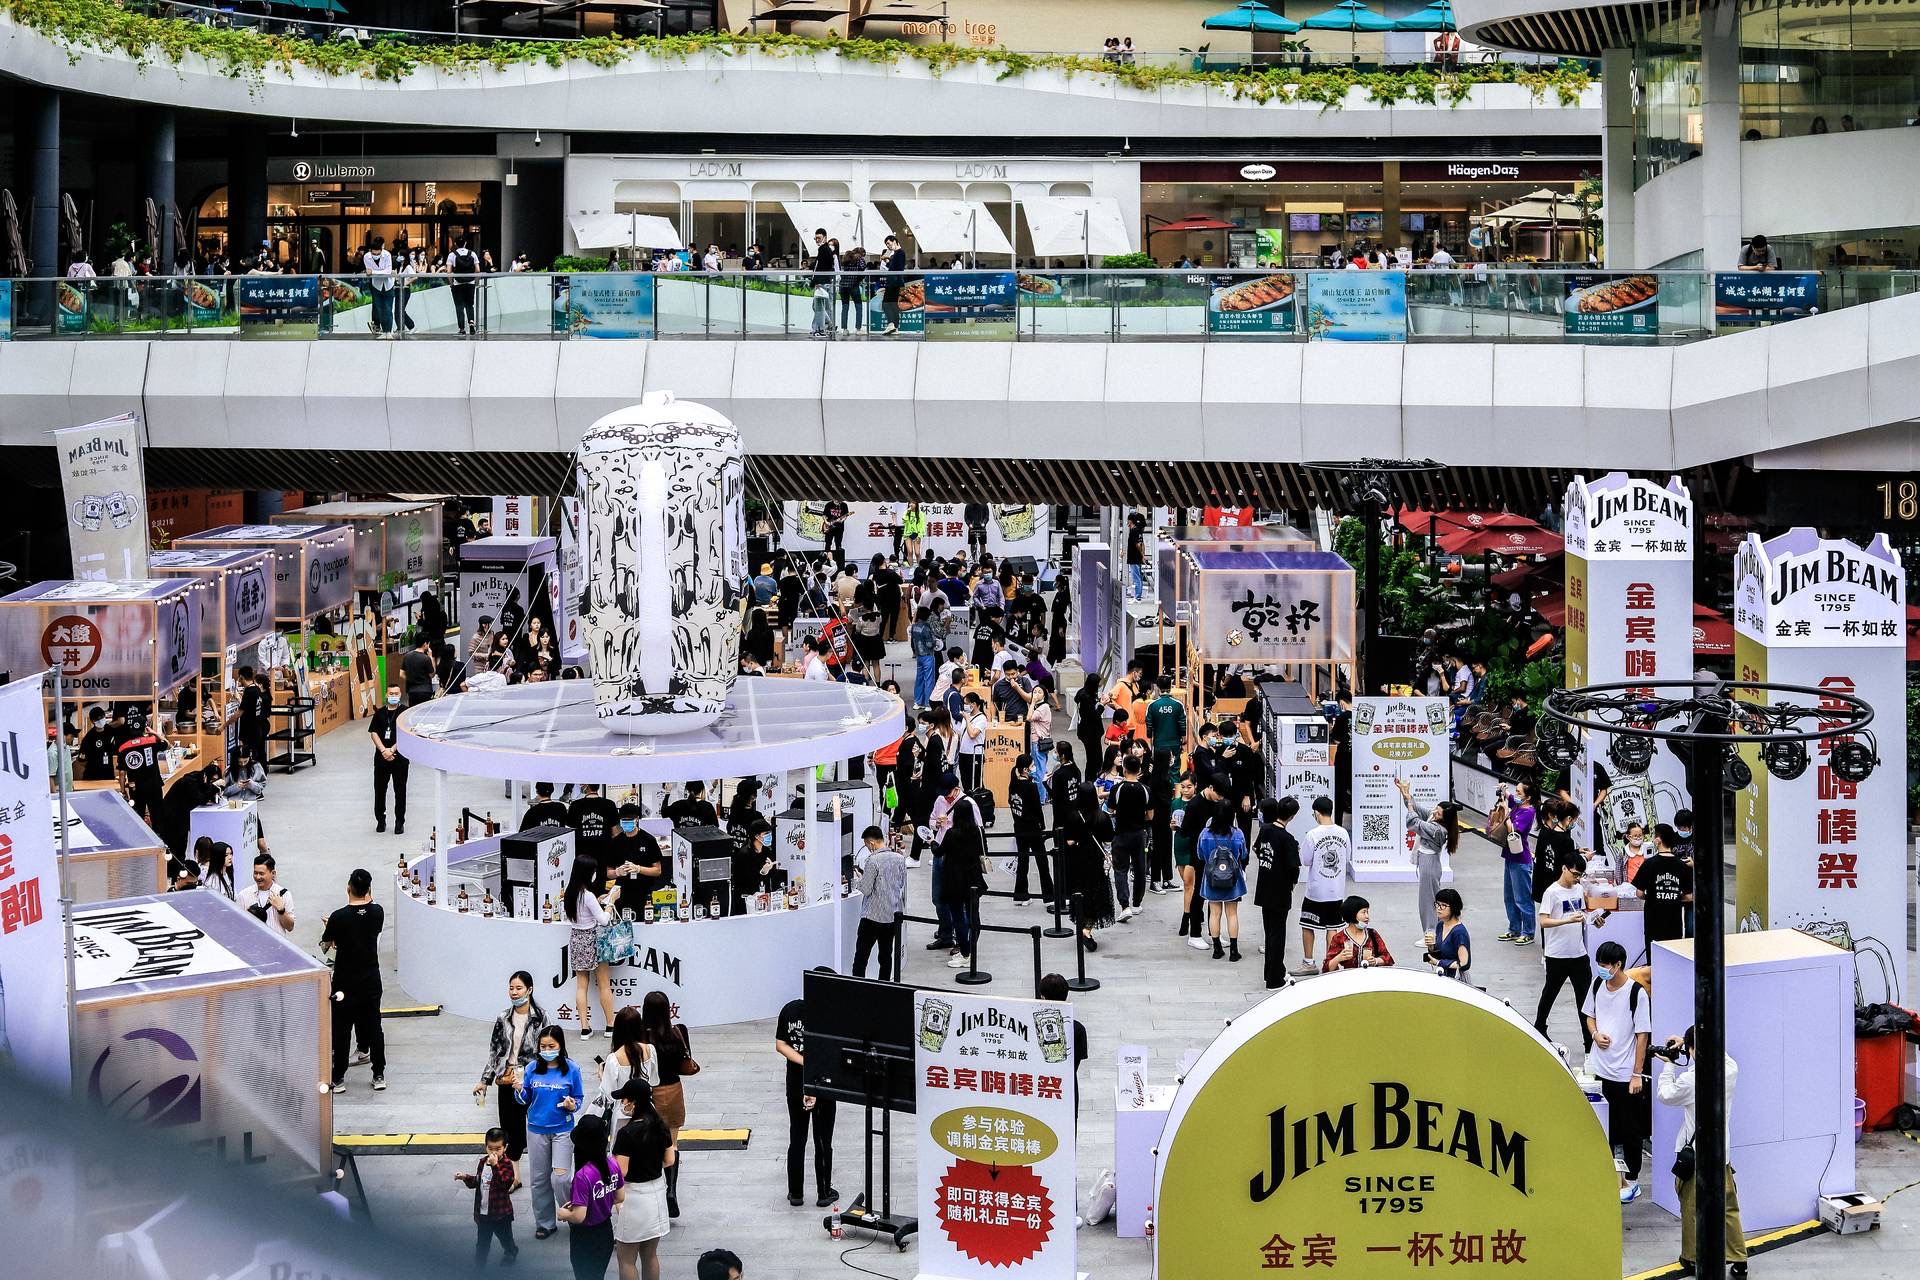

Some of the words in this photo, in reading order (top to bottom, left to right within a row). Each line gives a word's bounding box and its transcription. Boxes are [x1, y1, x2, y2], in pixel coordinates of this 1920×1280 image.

[964, 19, 996, 34] tree
[313, 163, 375, 178] lululemon
[1590, 494, 1628, 529] JIM
[1633, 486, 1689, 528] BEAM
[1876, 480, 1918, 521] 18
[505, 495, 519, 536] 宾嗨
[1594, 540, 1622, 553] 金宾
[1630, 540, 1688, 553] 一杯如故
[1771, 560, 1819, 606] JIM
[1826, 550, 1901, 606] BEAM
[470, 580, 488, 598] JIM
[1820, 604, 1850, 612] 1795
[1775, 620, 1811, 637] 金宾
[1824, 619, 1898, 637] 一杯如故
[72, 678, 110, 689] DONG
[1158, 706, 1173, 714] 456
[1386, 705, 1398, 716] JIM
[1398, 702, 1416, 716] BEAM
[1372, 724, 1429, 734] 金宾嗨棒祭
[998, 734, 1022, 752] BEAM
[1285, 774, 1302, 790] JIM
[1304, 770, 1330, 789] BEAM
[1622, 790, 1640, 800] BEAM
[74, 936, 111, 960] SINCE
[609, 978, 638, 986] NCE
[956, 1012, 984, 1037] JIM
[988, 1008, 1030, 1042] BEAM
[959, 1046, 980, 1057] 金宾
[986, 1048, 1028, 1061] 一杯如故
[926, 1065, 1063, 1100] 金宾嗨棒祭
[962, 1114, 1026, 1136] 参与体验
[946, 1130, 1042, 1156] 调制金宾嗨棒
[1249, 1102, 1359, 1202] JIM
[1368, 1081, 1531, 1198] BEAM
[1344, 1176, 1435, 1192] SINCE
[947, 1186, 1042, 1212] 即可获得金宾
[1359, 1198, 1424, 1214] 1795
[947, 1204, 1042, 1230] 随机礼品一份
[1260, 1233, 1338, 1269] 金宾
[1366, 1228, 1528, 1267] 一杯如故
